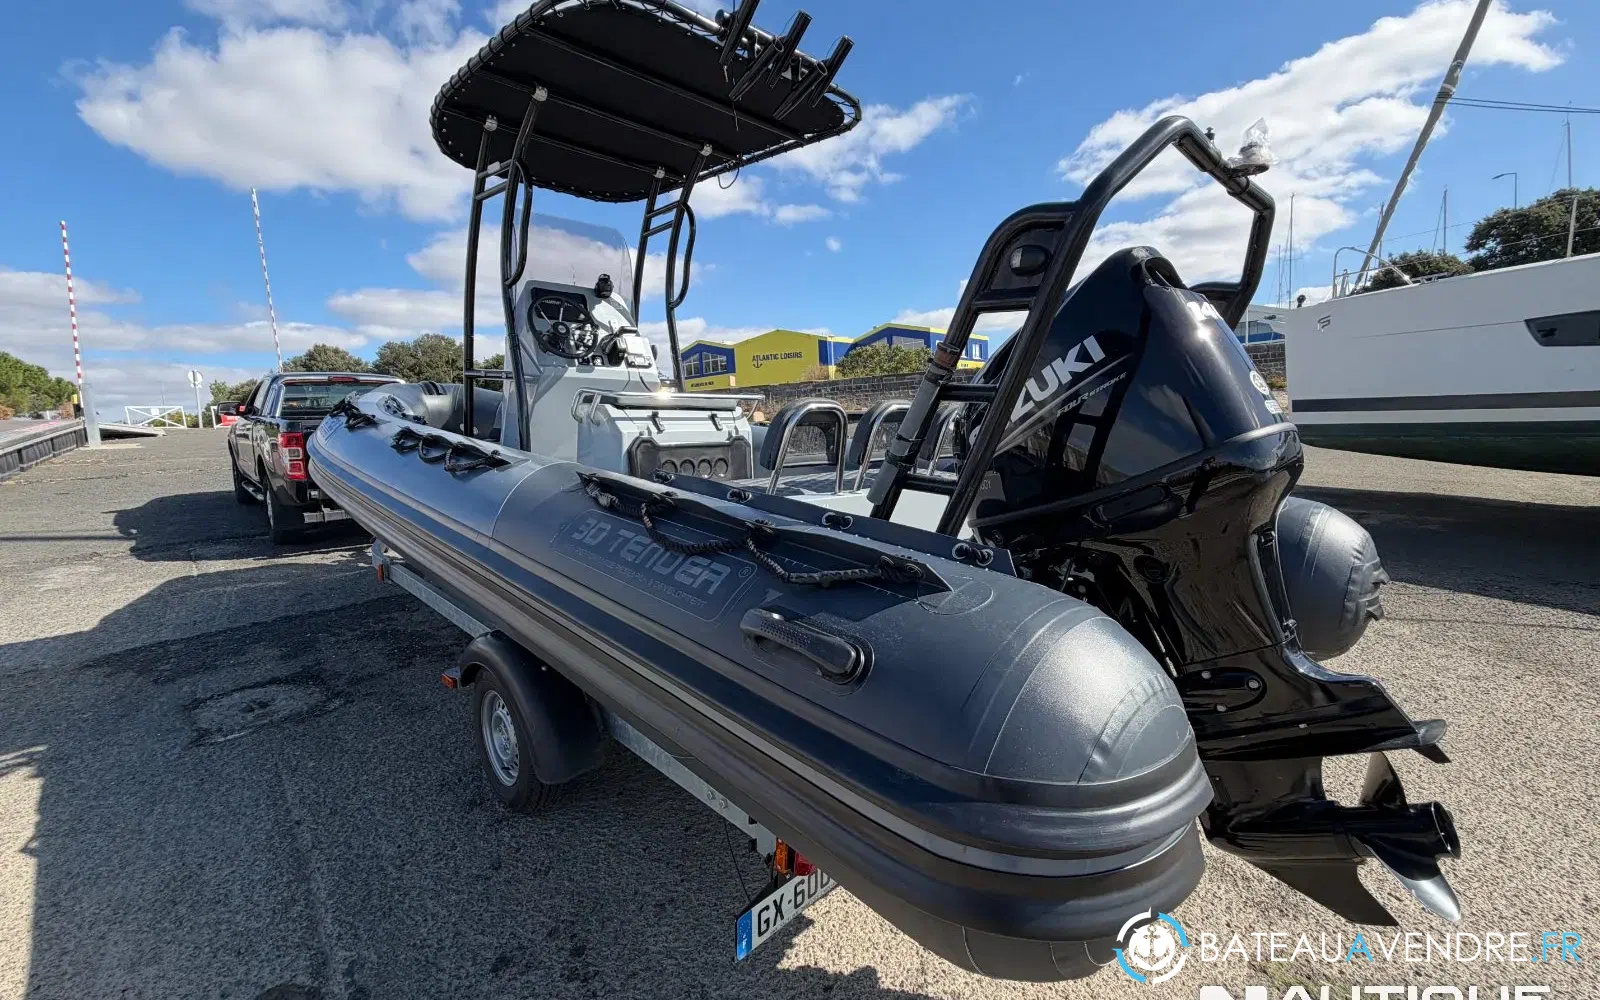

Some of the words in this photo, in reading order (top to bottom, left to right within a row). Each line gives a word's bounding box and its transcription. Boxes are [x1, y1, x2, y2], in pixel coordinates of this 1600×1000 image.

[752, 353, 779, 366] ATLANTIC
[780, 352, 803, 360] LOISIRS
[1056, 392, 1089, 417] FOUR
[572, 517, 611, 546] 3D
[608, 529, 730, 595] TENDER
